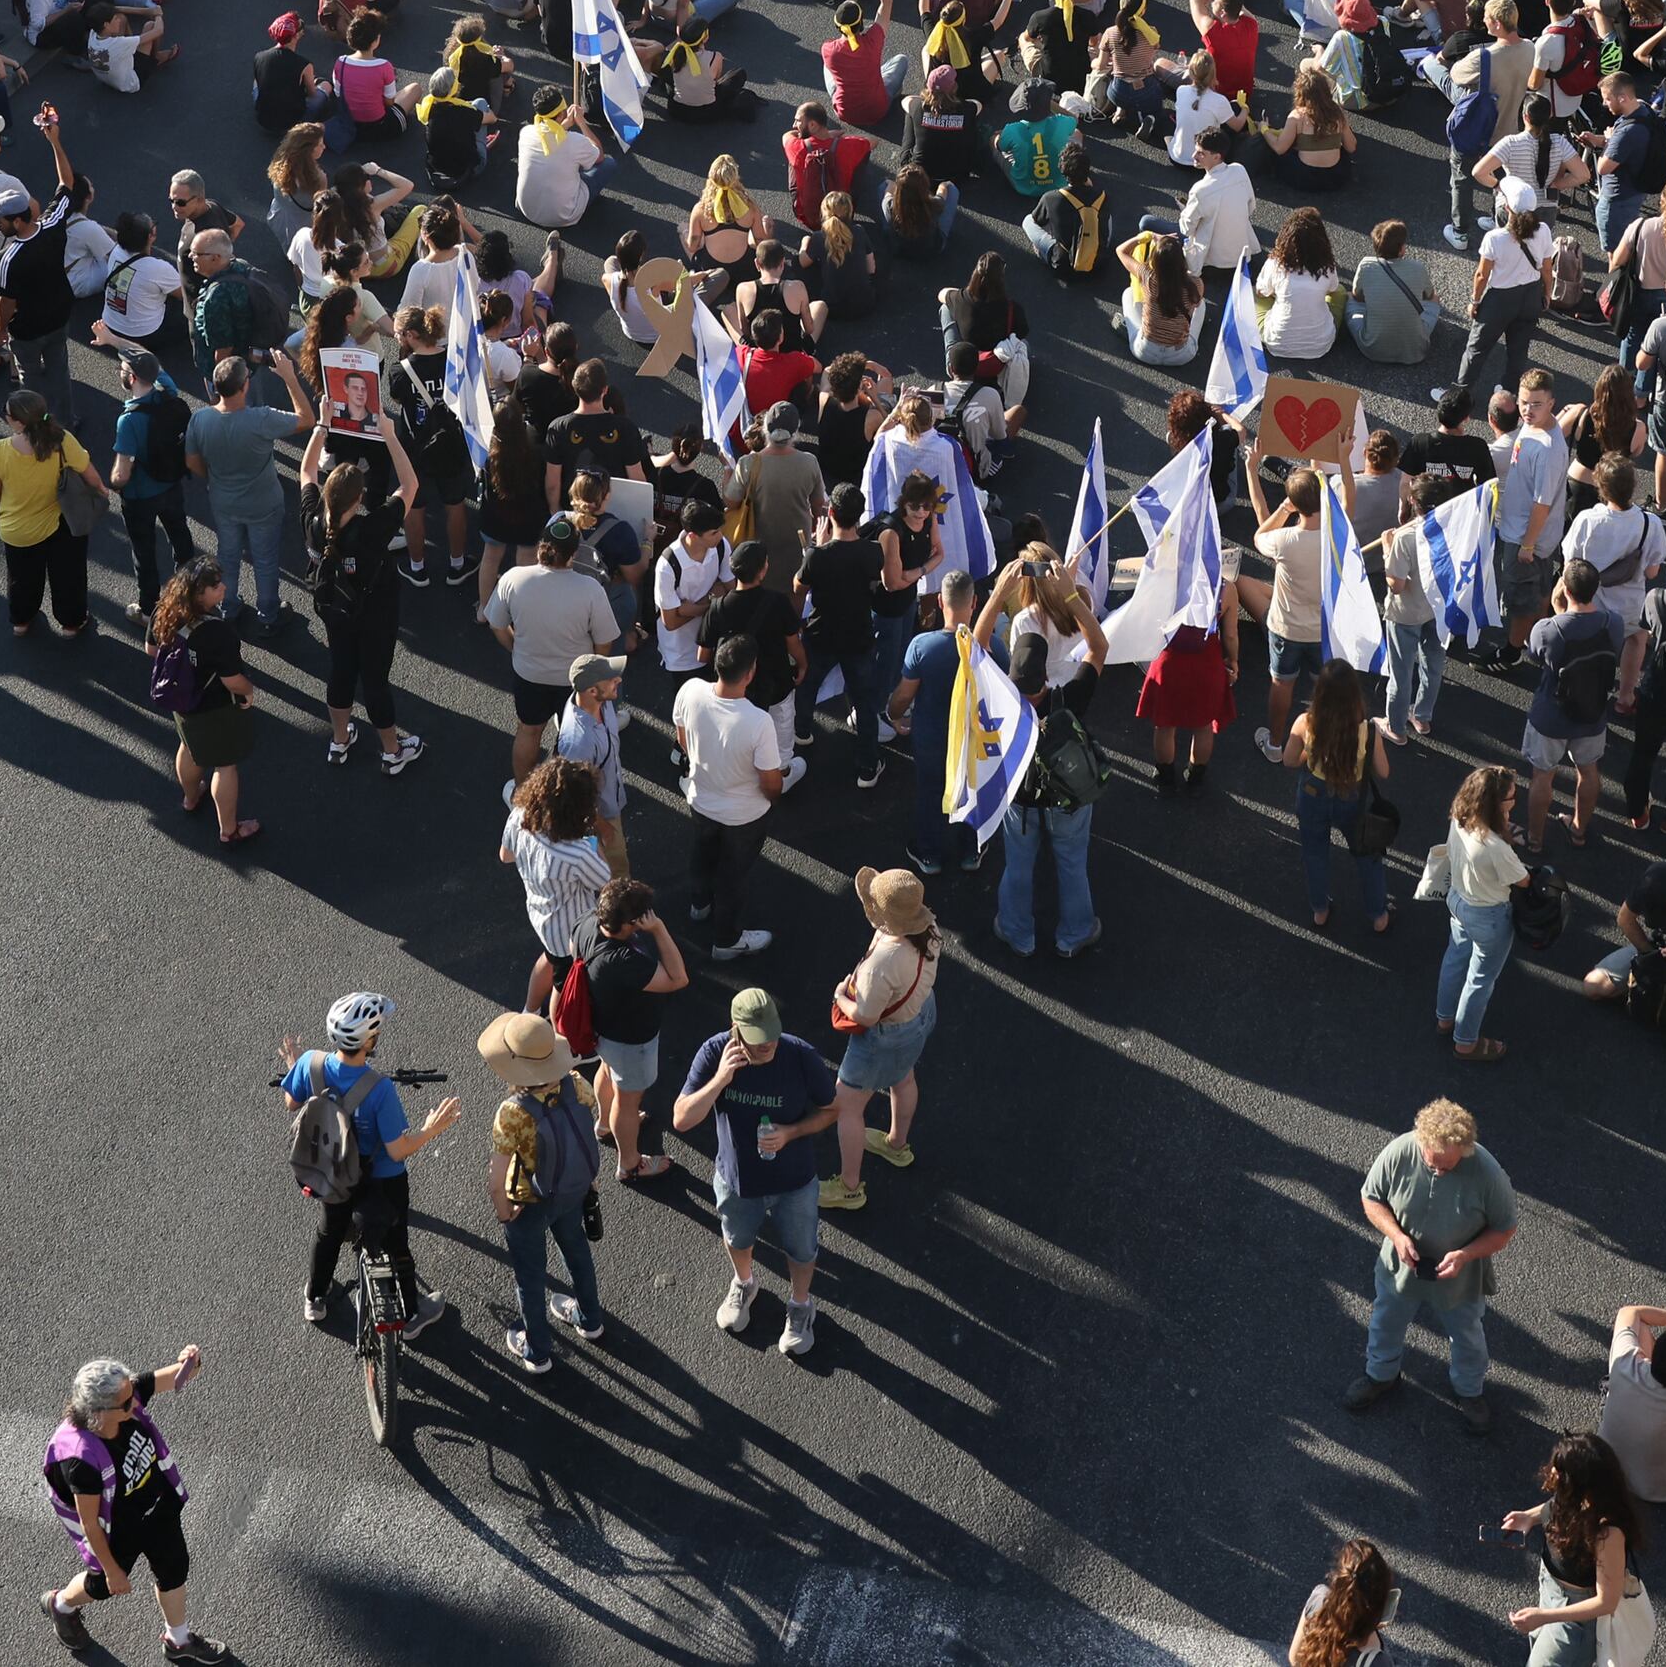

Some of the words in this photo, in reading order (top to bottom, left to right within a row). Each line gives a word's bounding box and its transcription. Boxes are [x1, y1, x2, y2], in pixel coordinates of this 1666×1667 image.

[922, 116, 945, 127] FAMILIES
[945, 117, 964, 128] FORUM
[1032, 132, 1044, 156] 1
[1033, 159, 1049, 179] 8
[1426, 468, 1452, 477] FAMILIES
